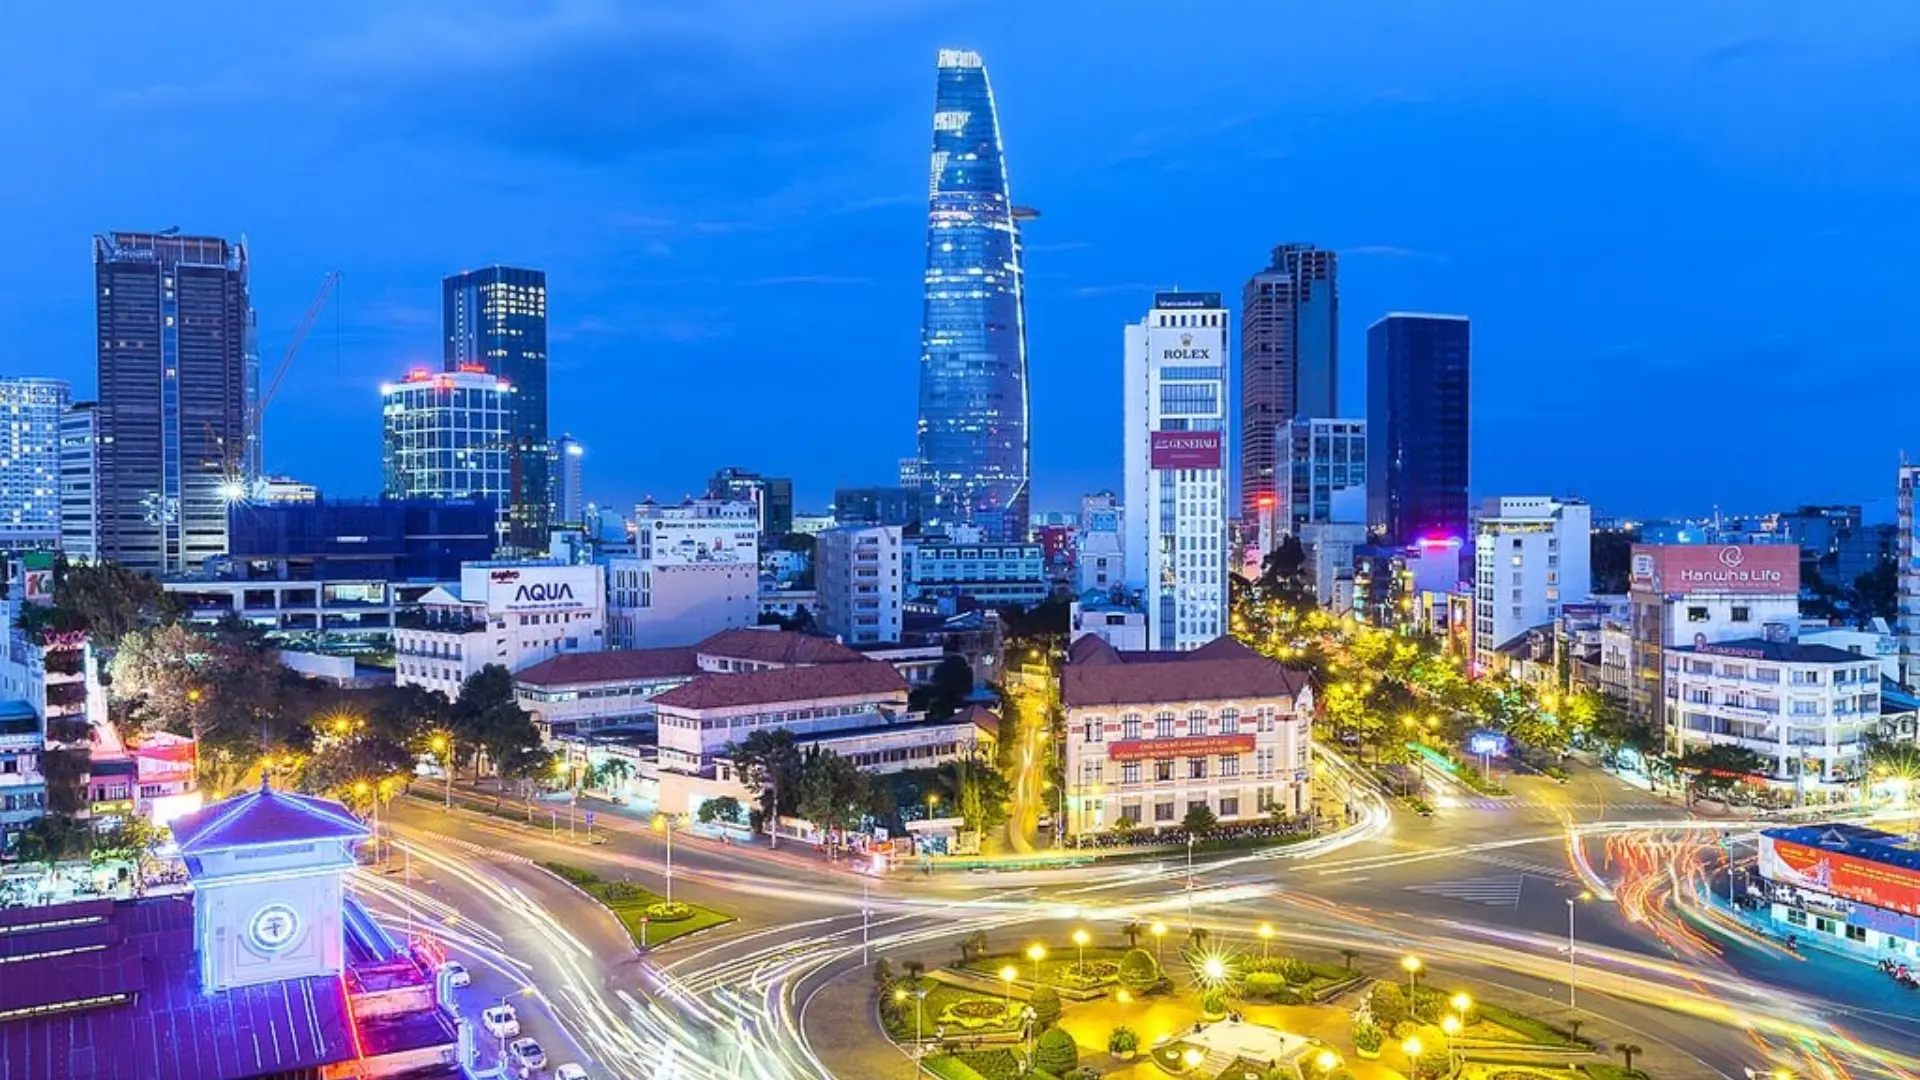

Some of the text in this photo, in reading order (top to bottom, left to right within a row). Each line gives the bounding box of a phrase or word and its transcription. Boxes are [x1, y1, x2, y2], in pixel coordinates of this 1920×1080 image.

[1164, 348, 1210, 359] ROLEX
[1169, 438, 1218, 449] GENERALI
[1681, 569, 1781, 581] Hanwha Life
[515, 583, 573, 601] AQUA
